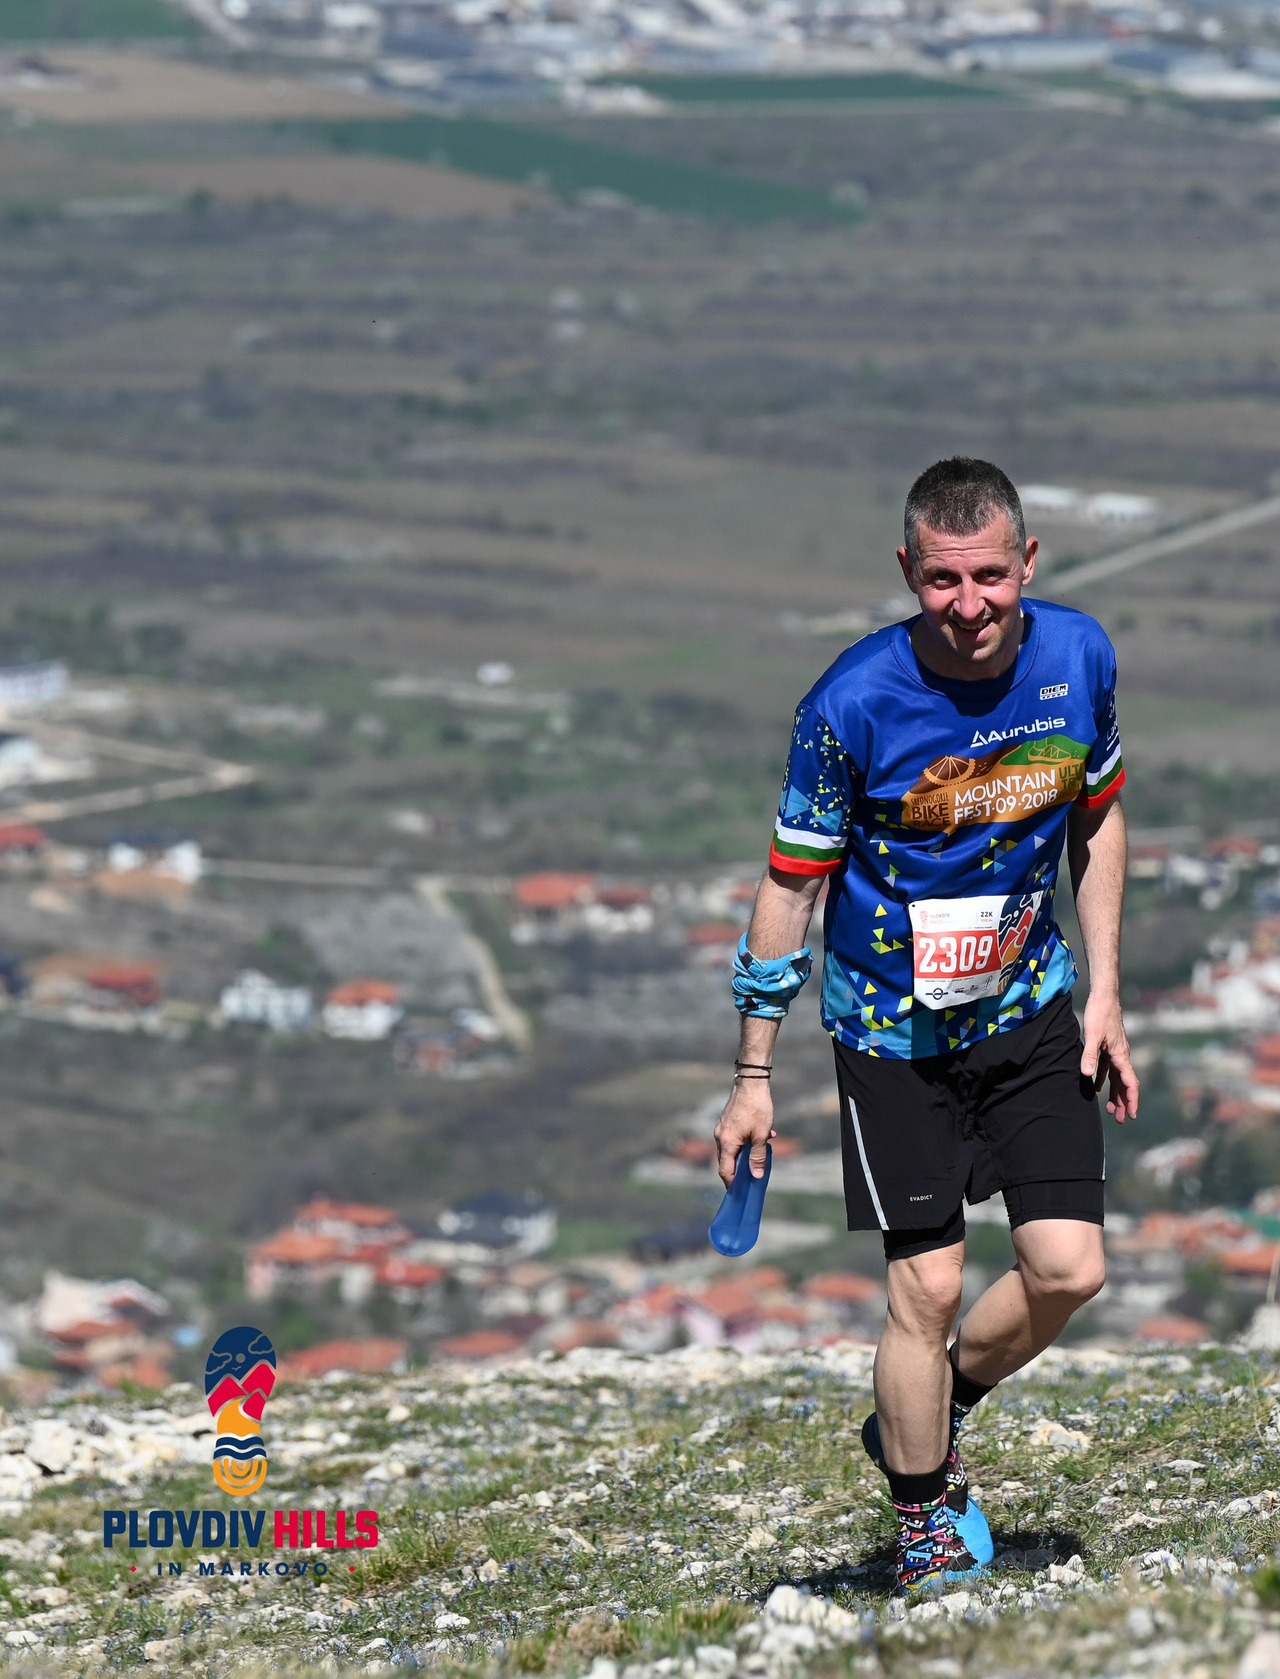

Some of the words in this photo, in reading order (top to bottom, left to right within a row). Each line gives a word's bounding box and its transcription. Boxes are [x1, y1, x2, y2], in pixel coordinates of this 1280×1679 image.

[1041, 684, 1067, 695] DIEM
[987, 716, 1066, 743] Aurubis
[954, 769, 1056, 807] MOUNTAIN
[912, 802, 949, 820] BIKE
[913, 816, 950, 827] RACE
[918, 935, 994, 974] 2309
